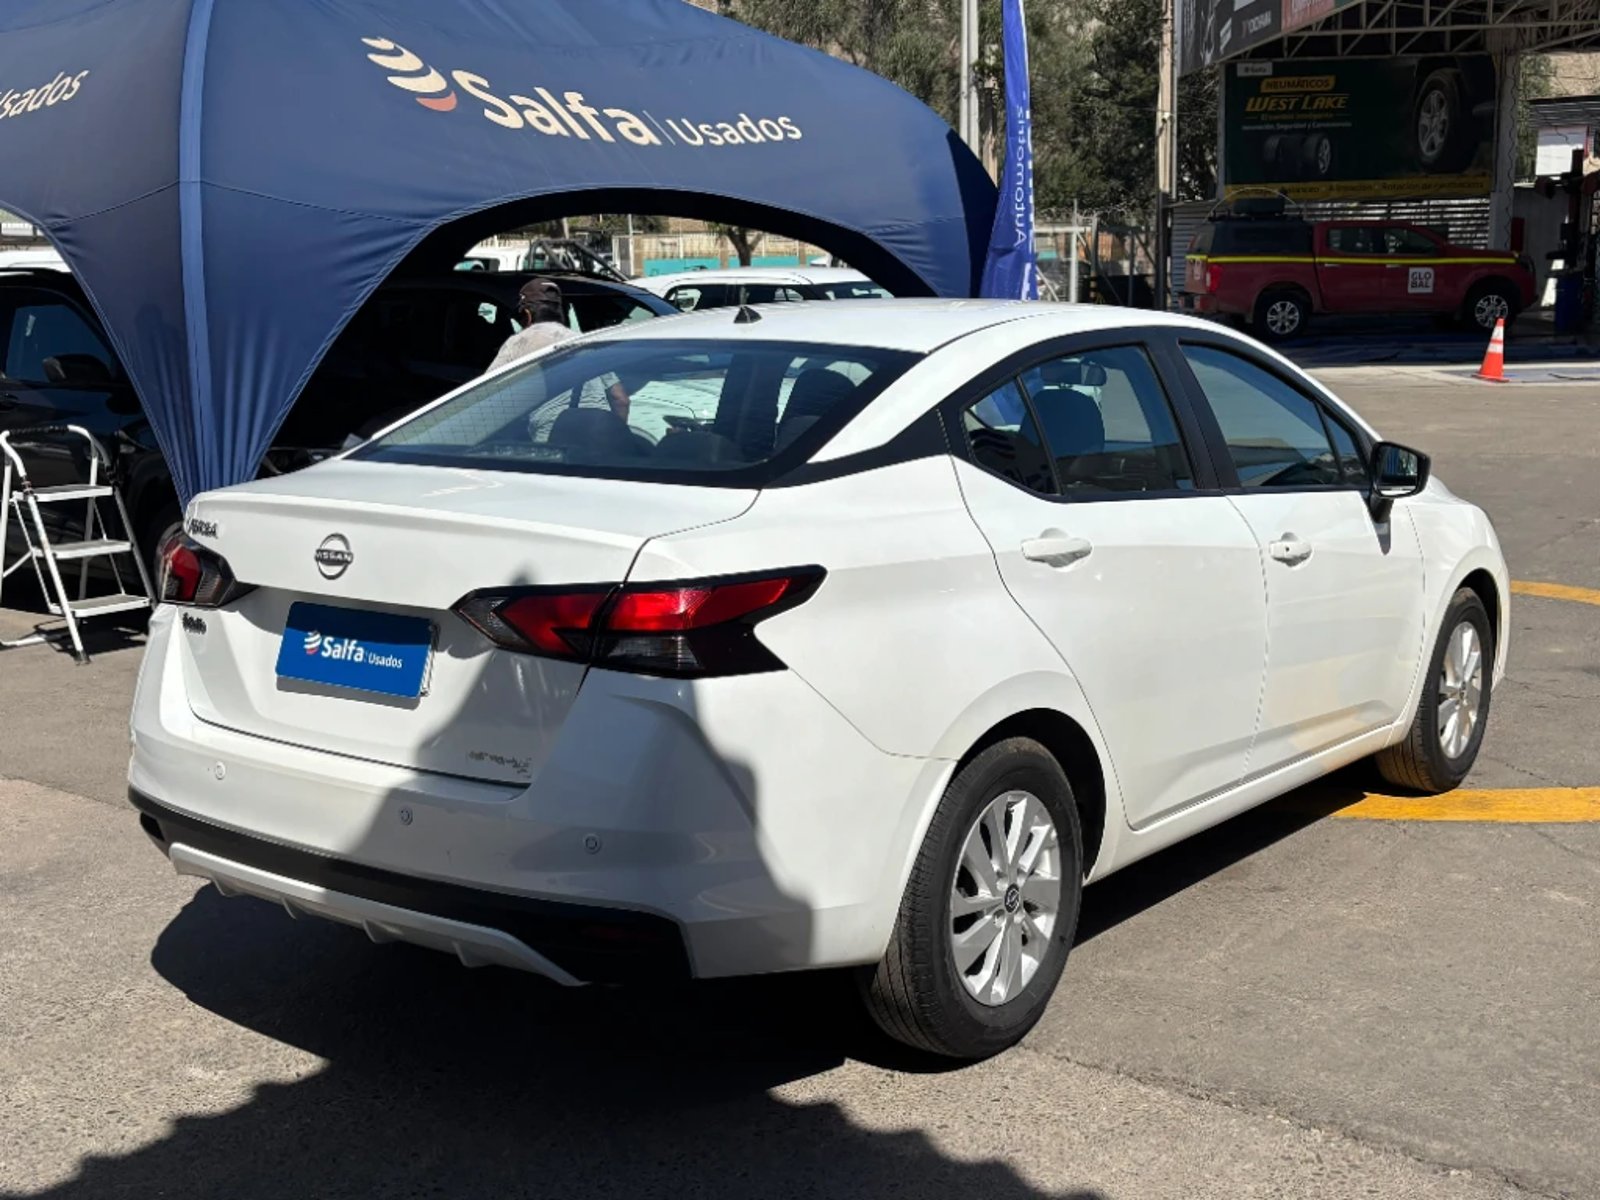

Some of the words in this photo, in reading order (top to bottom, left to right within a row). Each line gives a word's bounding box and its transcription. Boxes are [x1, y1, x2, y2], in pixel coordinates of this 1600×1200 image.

[452, 69, 662, 147] Salfa
[666, 112, 803, 147] Usados
[1411, 271, 1432, 281] GLO
[1411, 280, 1431, 288] BAL
[315, 550, 353, 562] NISSAN
[321, 636, 365, 662] Salfa
[368, 652, 403, 669] Usados
